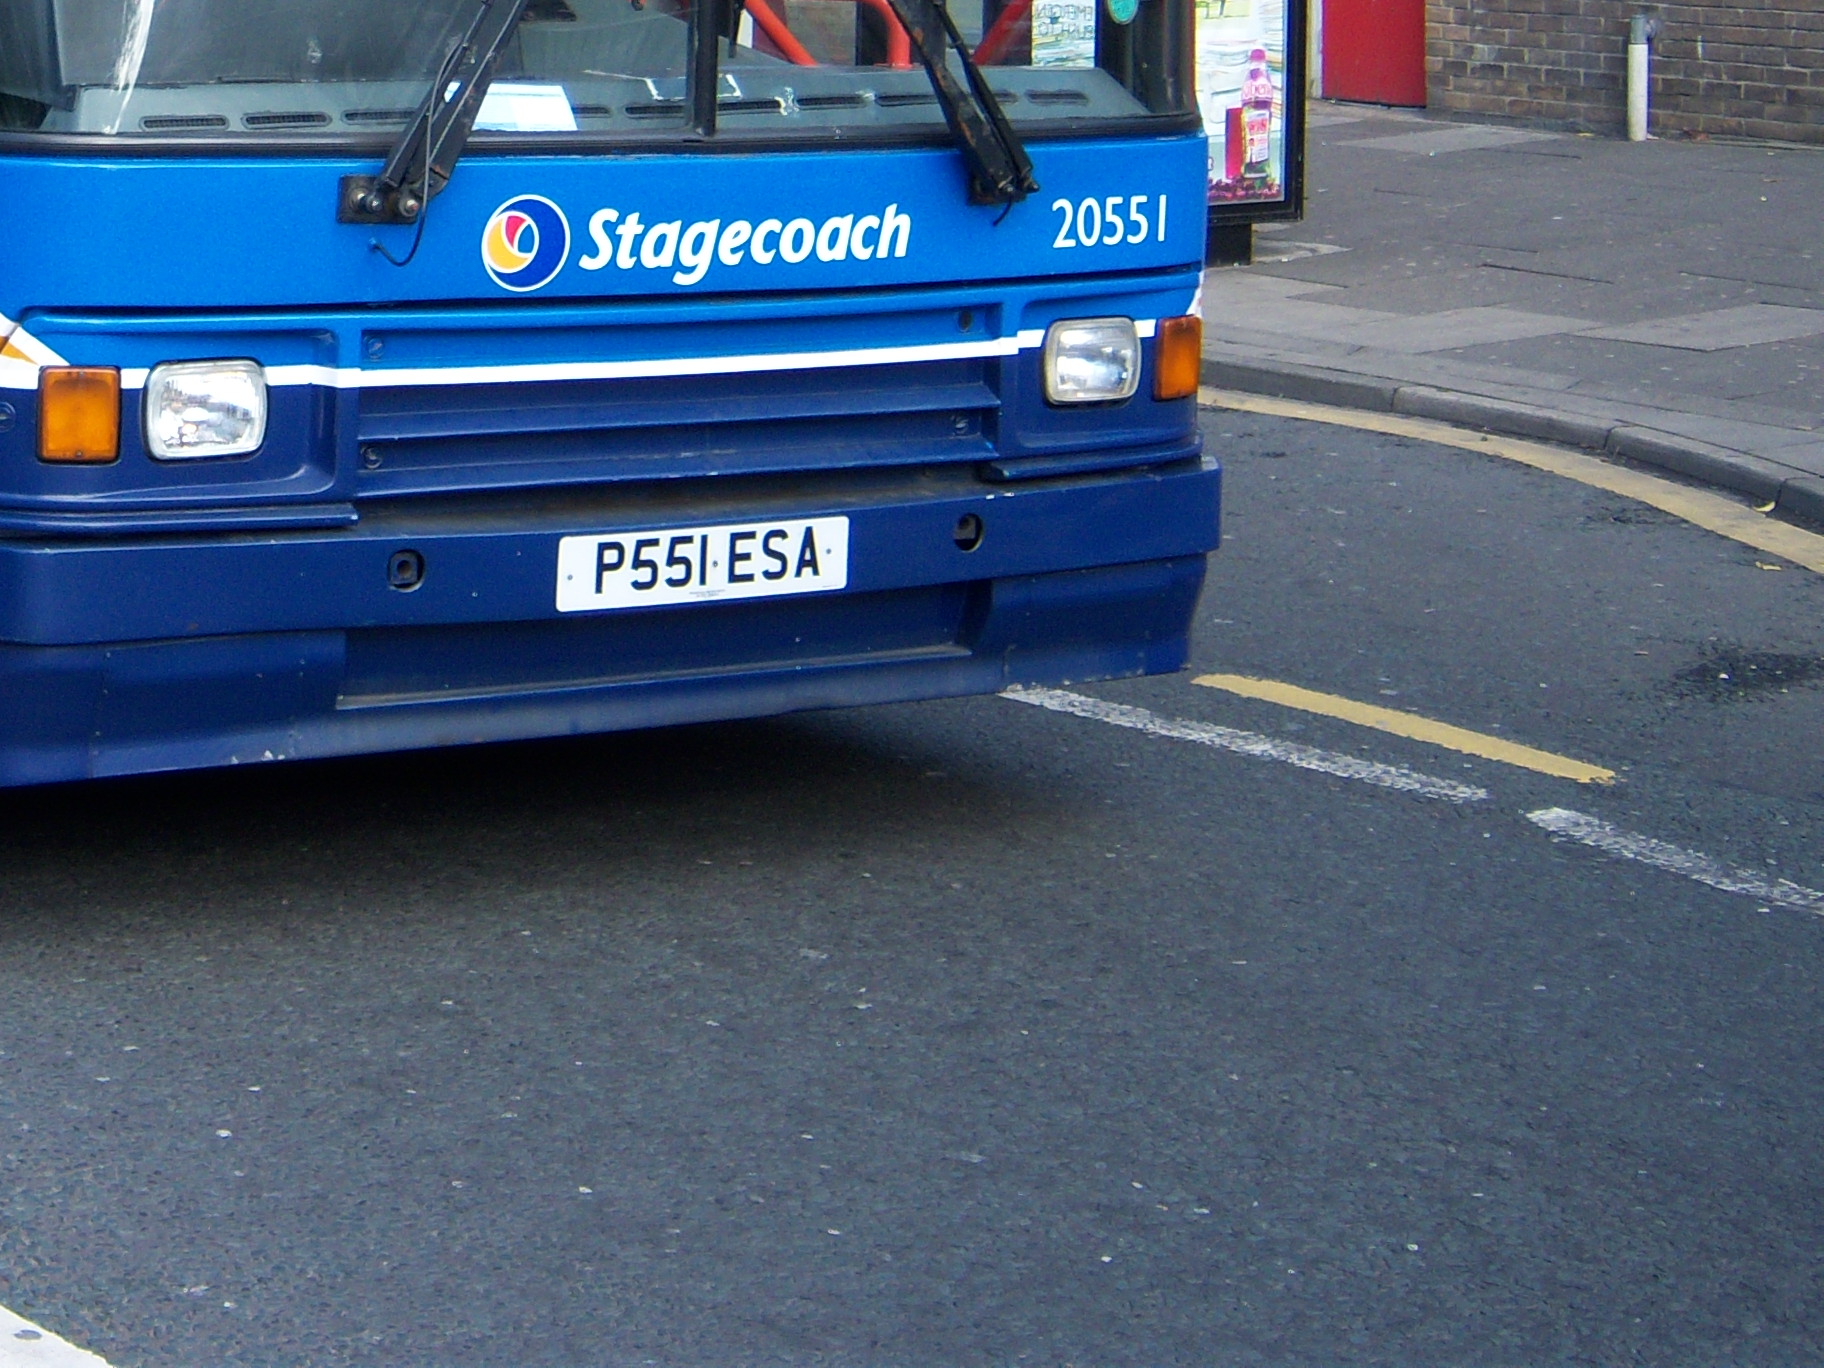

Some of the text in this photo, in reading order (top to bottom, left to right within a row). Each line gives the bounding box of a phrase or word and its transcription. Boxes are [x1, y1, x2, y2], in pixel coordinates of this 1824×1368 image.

[578, 203, 911, 285] Stagecoach
[1052, 194, 1167, 248] 20551
[594, 526, 821, 594] P551 ESA
